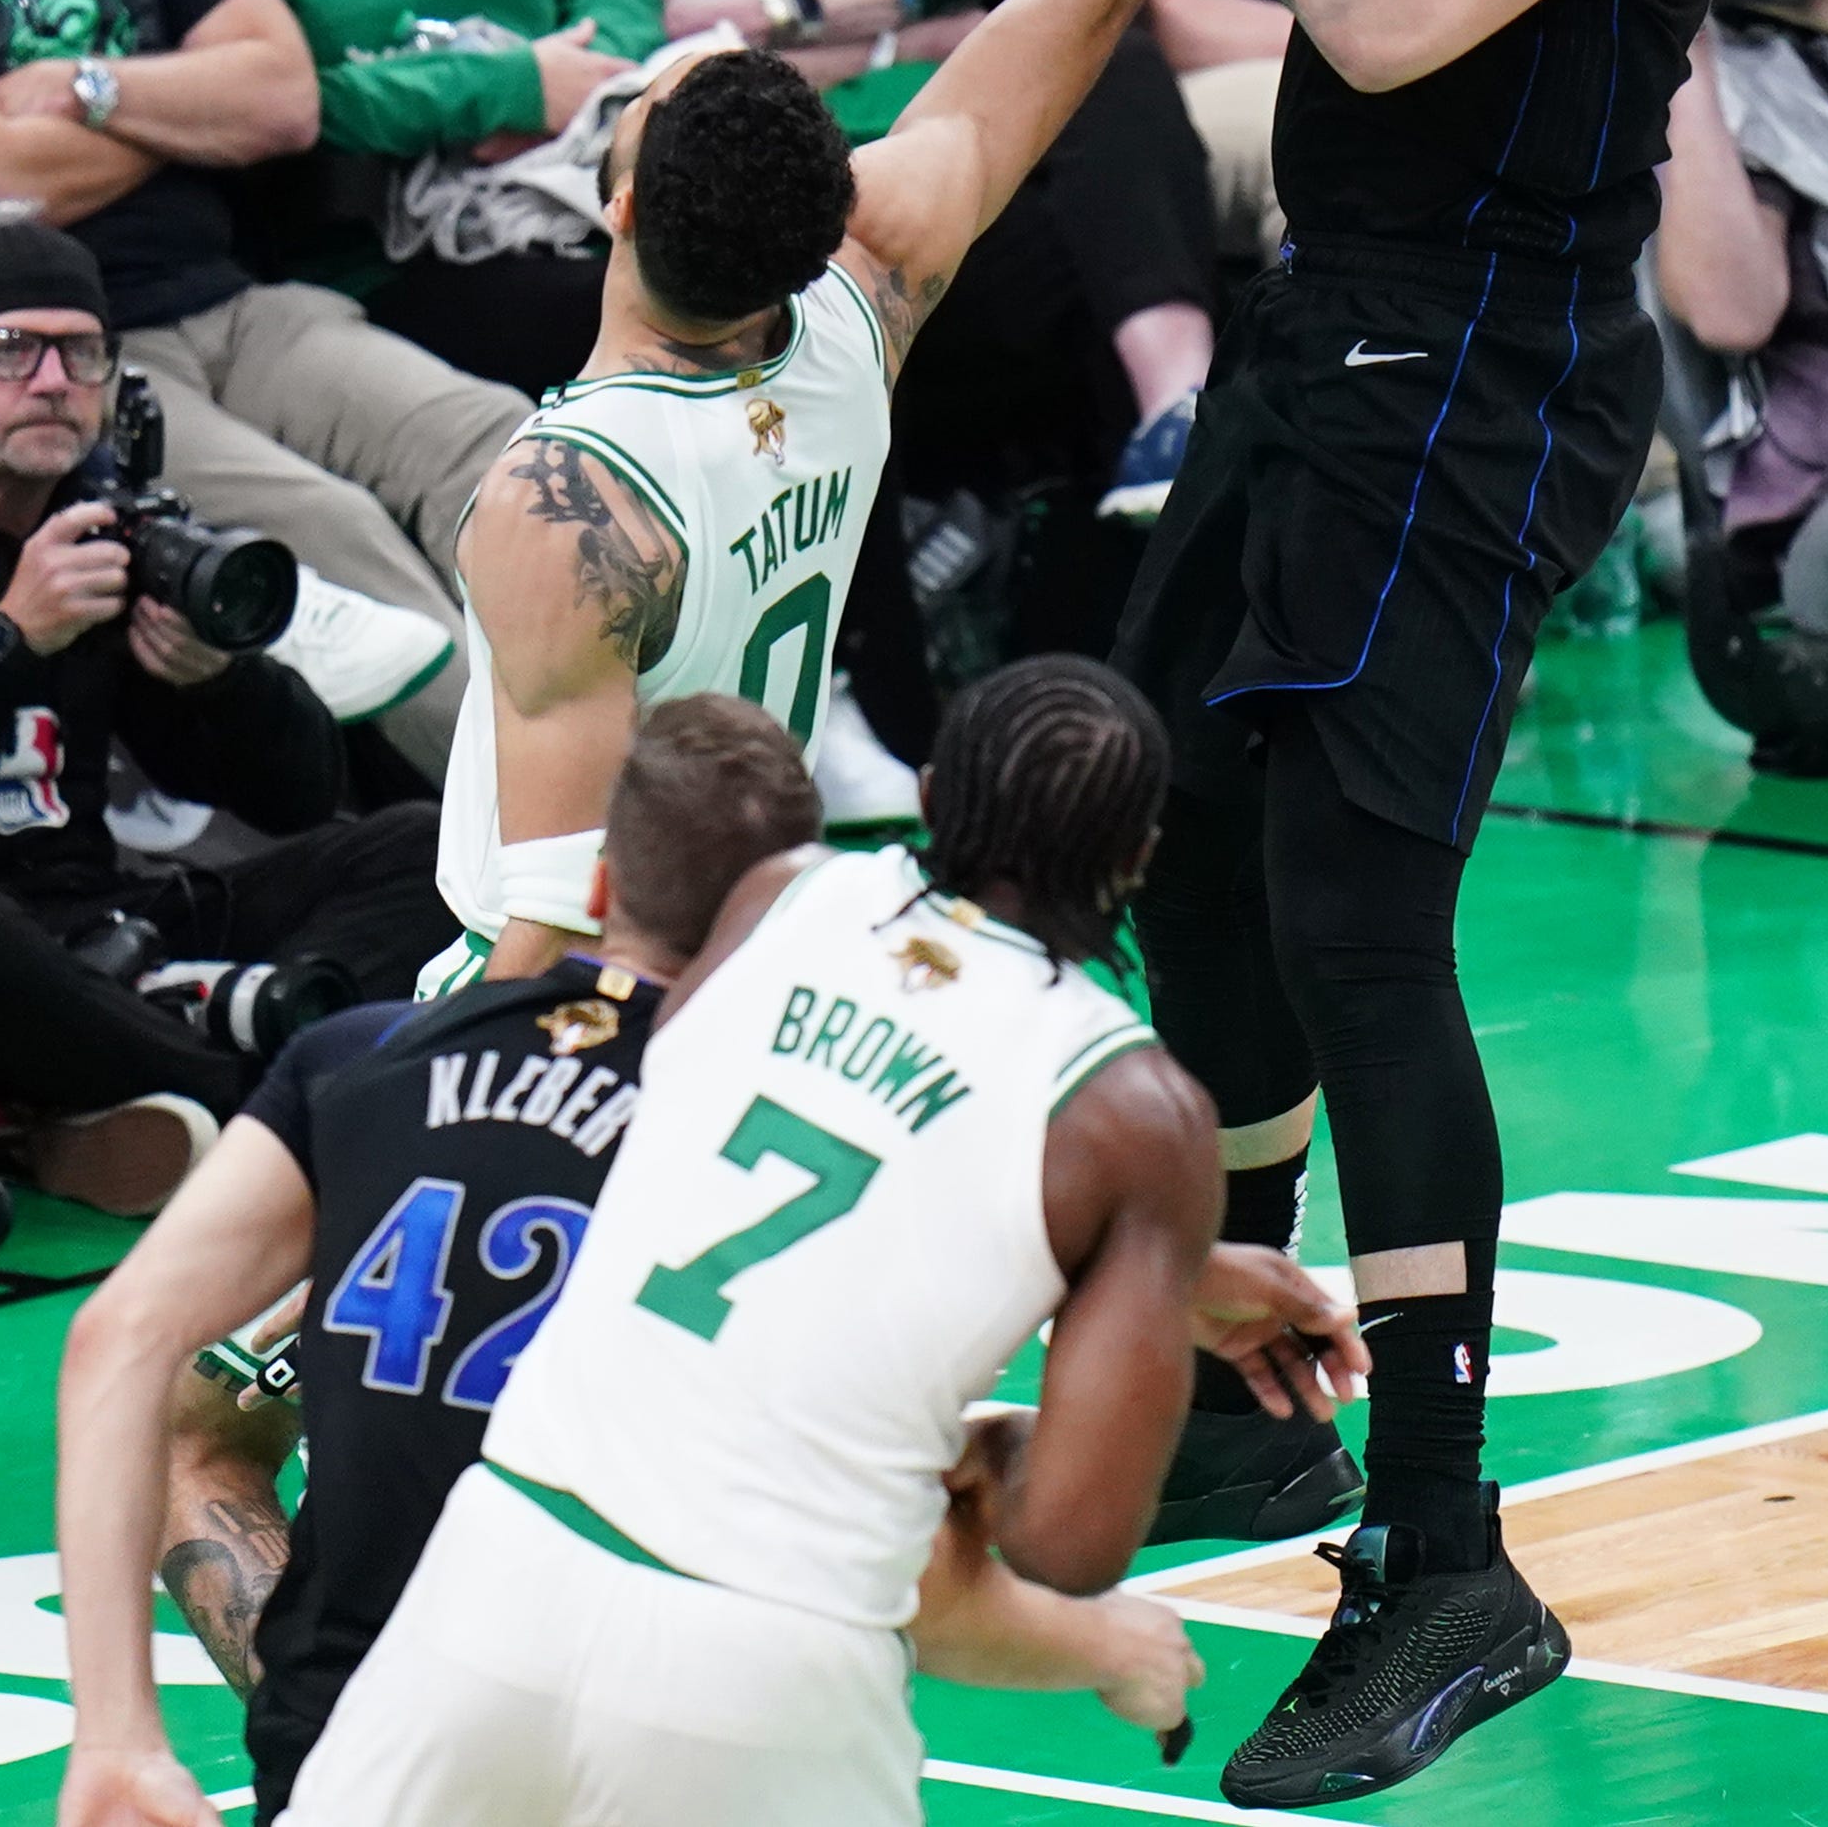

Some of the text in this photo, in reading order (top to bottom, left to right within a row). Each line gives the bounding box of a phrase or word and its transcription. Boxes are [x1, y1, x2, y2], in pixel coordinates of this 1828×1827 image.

[729, 465, 852, 596] TATUM
[737, 571, 832, 761] 0
[426, 1048, 641, 1158] KLEBER
[771, 984, 973, 1135] BROWN
[321, 1176, 596, 1414] 42
[634, 1092, 885, 1345] 7
